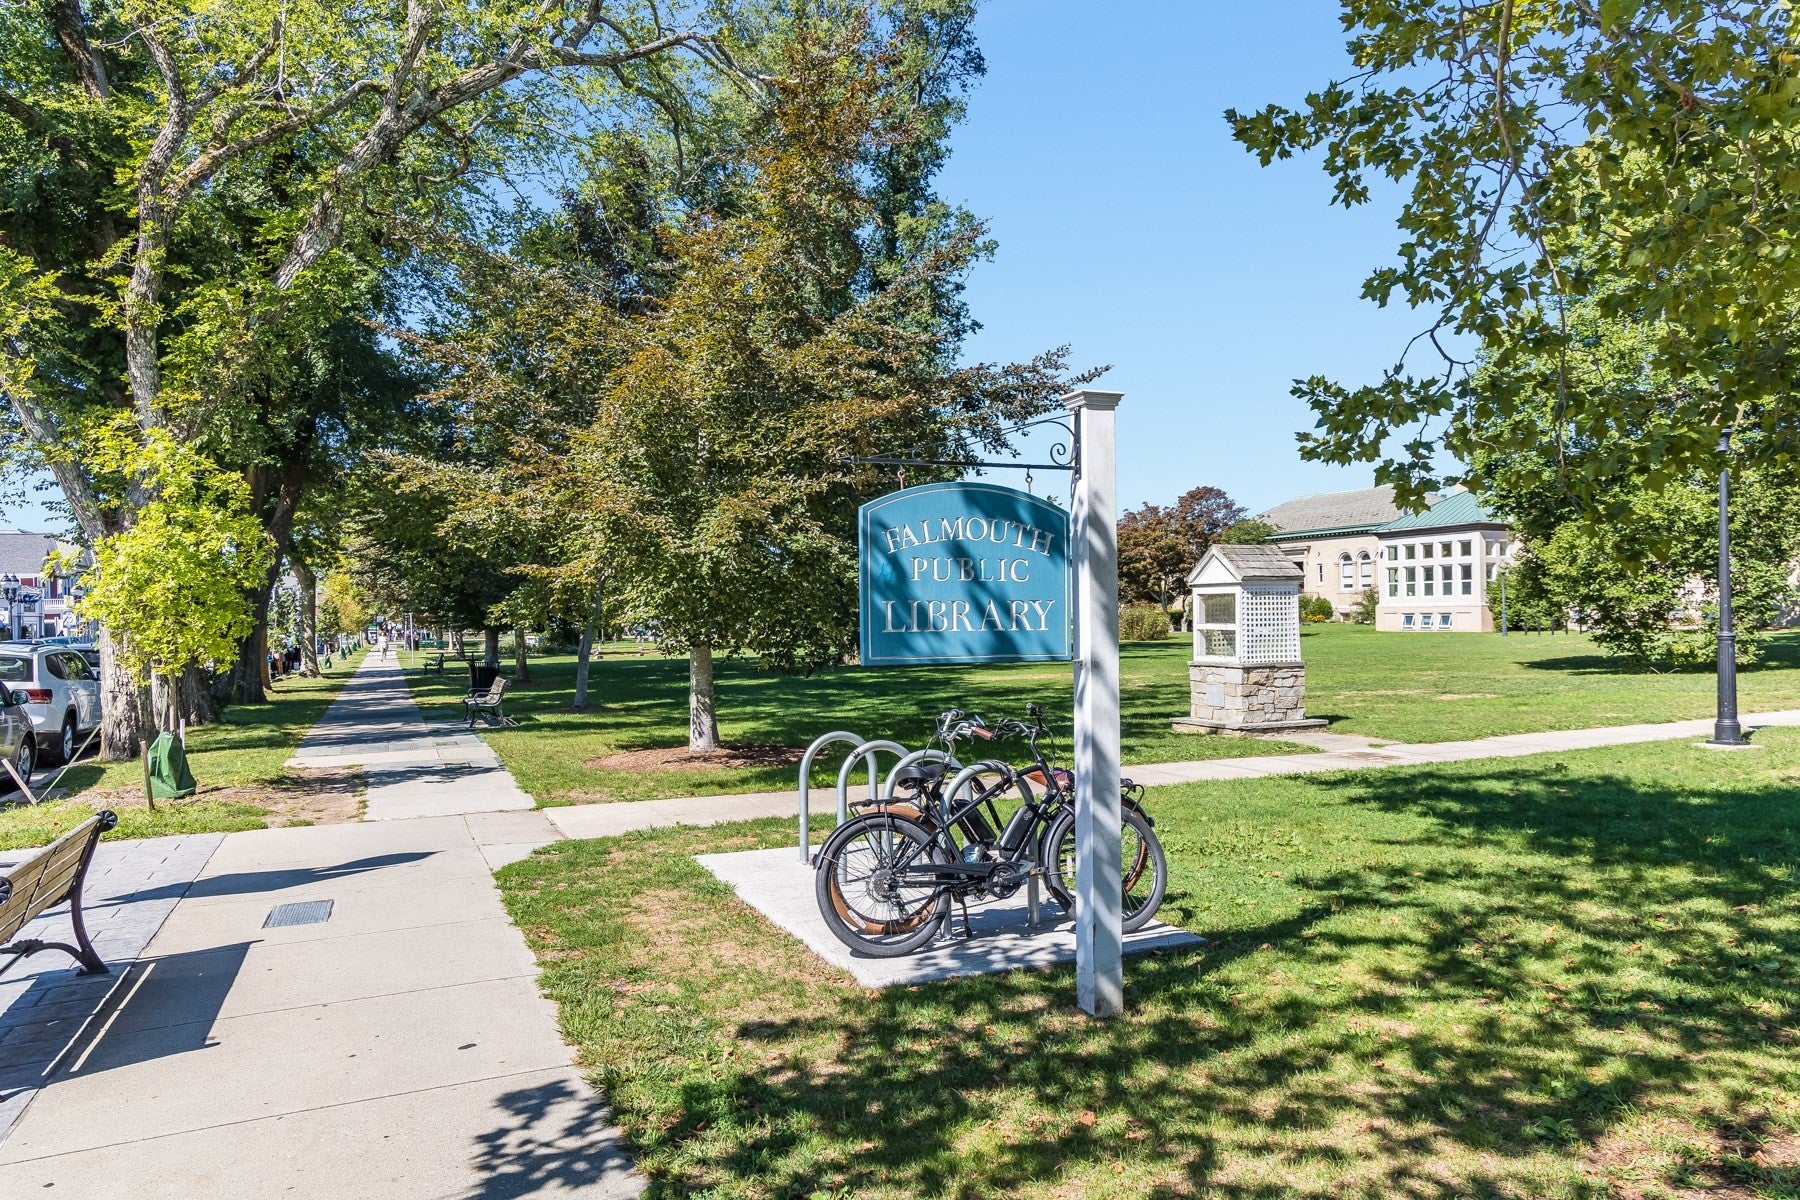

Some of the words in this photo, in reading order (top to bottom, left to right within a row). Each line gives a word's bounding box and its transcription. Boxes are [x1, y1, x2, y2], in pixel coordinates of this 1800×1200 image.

[882, 516, 1055, 557] FALMOUTH
[910, 557, 1030, 583] PUBLIC
[882, 599, 1056, 633] LIBRARY
